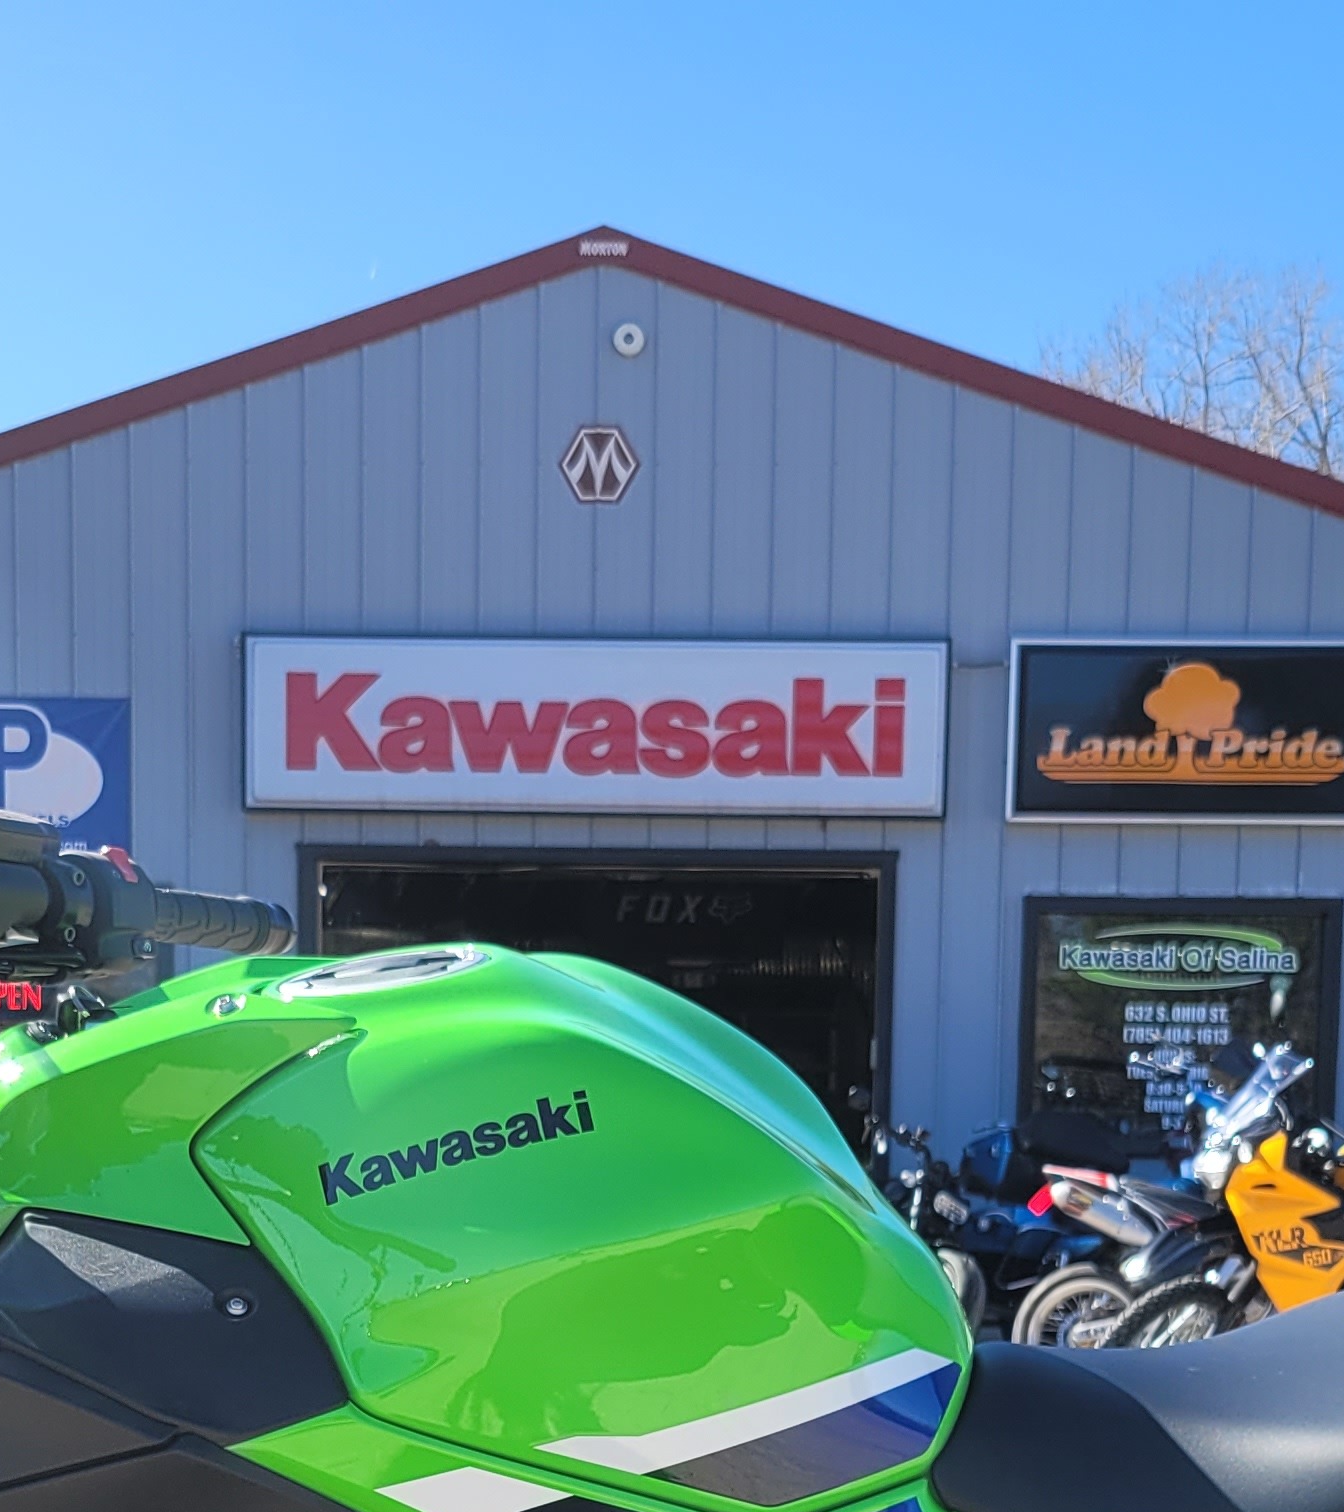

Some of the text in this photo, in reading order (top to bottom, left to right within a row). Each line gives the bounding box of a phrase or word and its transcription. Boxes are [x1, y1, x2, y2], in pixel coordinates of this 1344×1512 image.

[285, 672, 906, 778] Kawasaki
[1044, 728, 1344, 770] Land Pride
[617, 895, 703, 923] FOX
[1059, 945, 1297, 973] Kawasaki Of Salina
[1125, 1004, 1154, 1022] 632
[1172, 1004, 1207, 1022] OHIO
[318, 1089, 595, 1206] Kawasaki
[1302, 1248, 1333, 1266] 650
